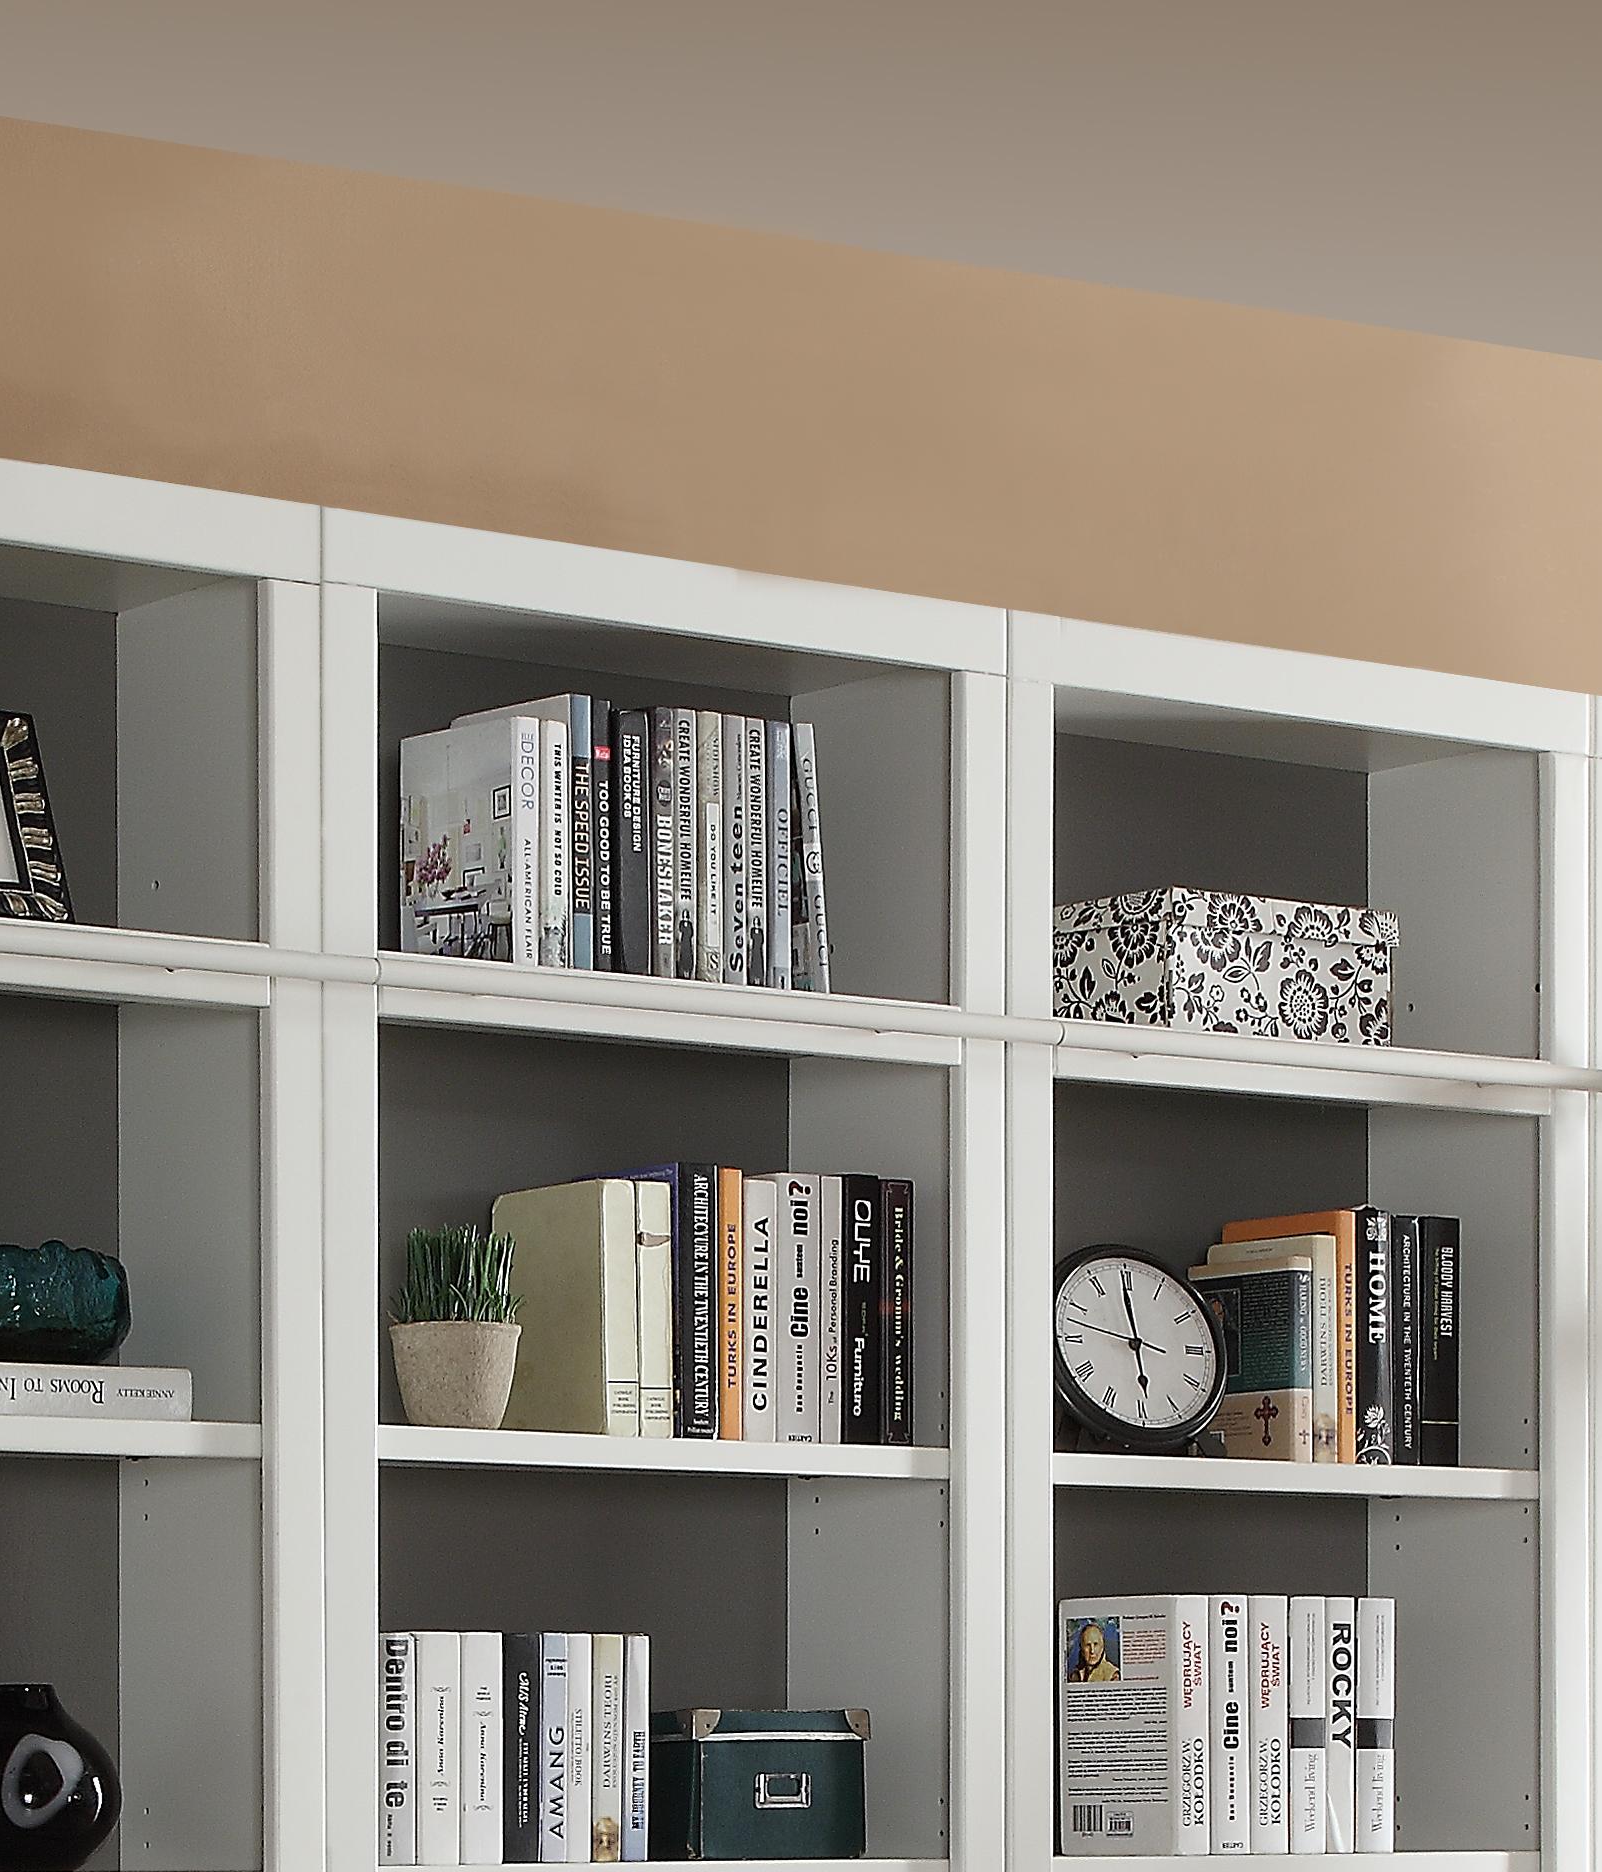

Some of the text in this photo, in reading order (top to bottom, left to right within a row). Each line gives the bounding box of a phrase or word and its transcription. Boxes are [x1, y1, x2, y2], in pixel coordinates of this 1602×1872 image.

[554, 744, 562, 896] THIS WINTER IS NOT SO COLD
[622, 735, 631, 800] IDEA BOOK
[631, 736, 641, 852] FURNITURE DESIGN
[679, 719, 691, 900] CREATE WONDERFUL HOMELIFE
[749, 729, 763, 909] CREATE WONDERFUL HOMELIFE
[802, 757, 817, 831] GUCCI
[575, 763, 590, 909] THE SPEED ISSUE
[598, 781, 611, 955] TOO GOOD TO BE TRUE
[656, 814, 673, 945] BONESHAKER
[710, 825, 716, 838] DO
[730, 805, 743, 875] teen
[777, 808, 788, 917] OFFICIEL
[523, 839, 533, 958] ALL-AMERICAN FLAIR
[710, 903, 716, 915] IT
[730, 883, 743, 972] Seven
[814, 894, 828, 967] GUCCI
[727, 1224, 736, 1388] TURKS IN EUROPE
[752, 1218, 769, 1410] CINDERELLA
[789, 1181, 811, 1339] Cine noi?
[825, 1238, 840, 1380] 10Ks Personal Branding
[894, 1207, 904, 1421] Bride & wedding
[1369, 1251, 1386, 1343] HOME
[1402, 1234, 1412, 1308] ARCHITECTURE
[1402, 1311, 1412, 1321] IN
[1441, 1247, 1453, 1336] BLOODY HARVEST
[24, 1378, 44, 1392] TO
[694, 1262, 708, 1417] IN THE TWENTIETH CENTURY
[1344, 1263, 1352, 1414] TURKS IN EUROPE
[1402, 1324, 1412, 1344] THE
[51, 1379, 104, 1404] ROOMS
[1402, 1404, 1412, 1449] CENTURY
[1183, 1621, 1193, 1708] WĘDRUJĄCY
[1221, 1601, 1240, 1750] Cine noi?
[1332, 1623, 1351, 1749] ROCKY
[385, 1639, 409, 1808] Dentro di te
[549, 1727, 564, 1839] AMANG
